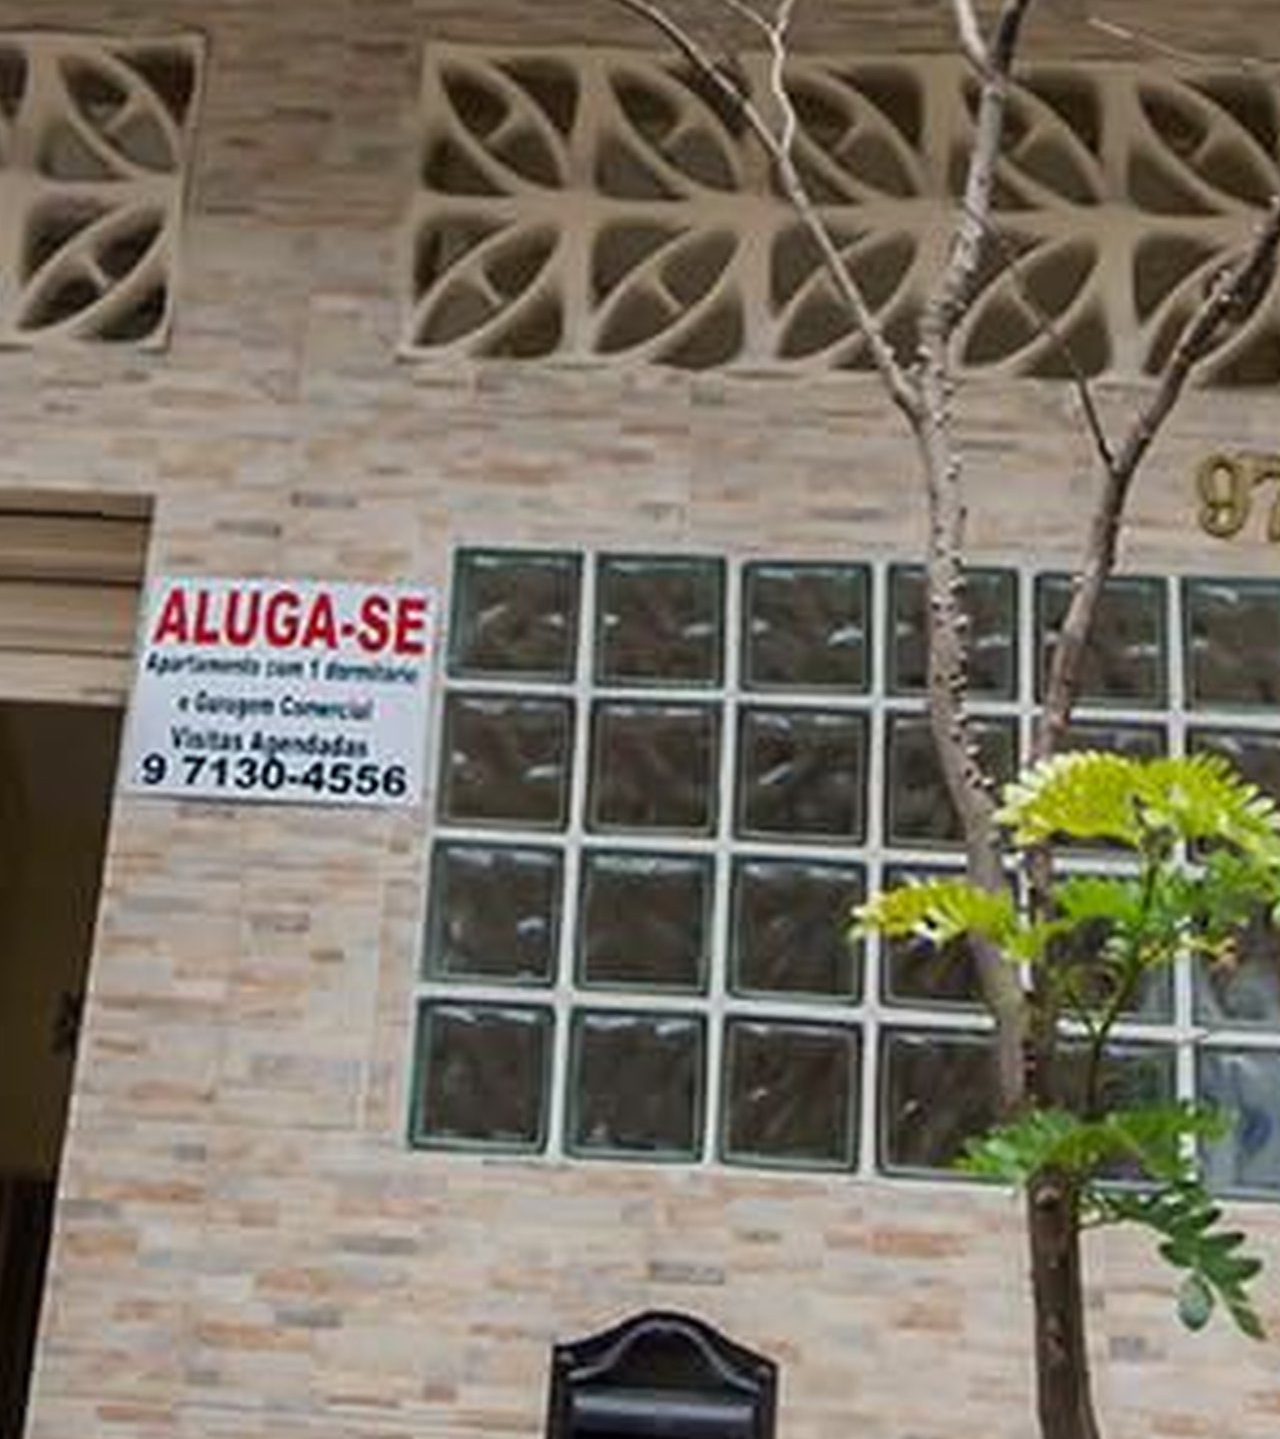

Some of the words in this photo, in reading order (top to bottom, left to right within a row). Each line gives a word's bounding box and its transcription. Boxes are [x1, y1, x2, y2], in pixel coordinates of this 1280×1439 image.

[152, 586, 428, 654] ALUGA-SE
[146, 652, 260, 677] Apartamento
[266, 660, 303, 679] com
[310, 658, 320, 679] 1
[195, 690, 275, 719] Garagem
[280, 694, 375, 721] Comercial
[170, 726, 243, 751] Visitas
[250, 732, 369, 759] Agendadas
[142, 753, 168, 785] 9
[183, 756, 408, 797] 7130-4556
